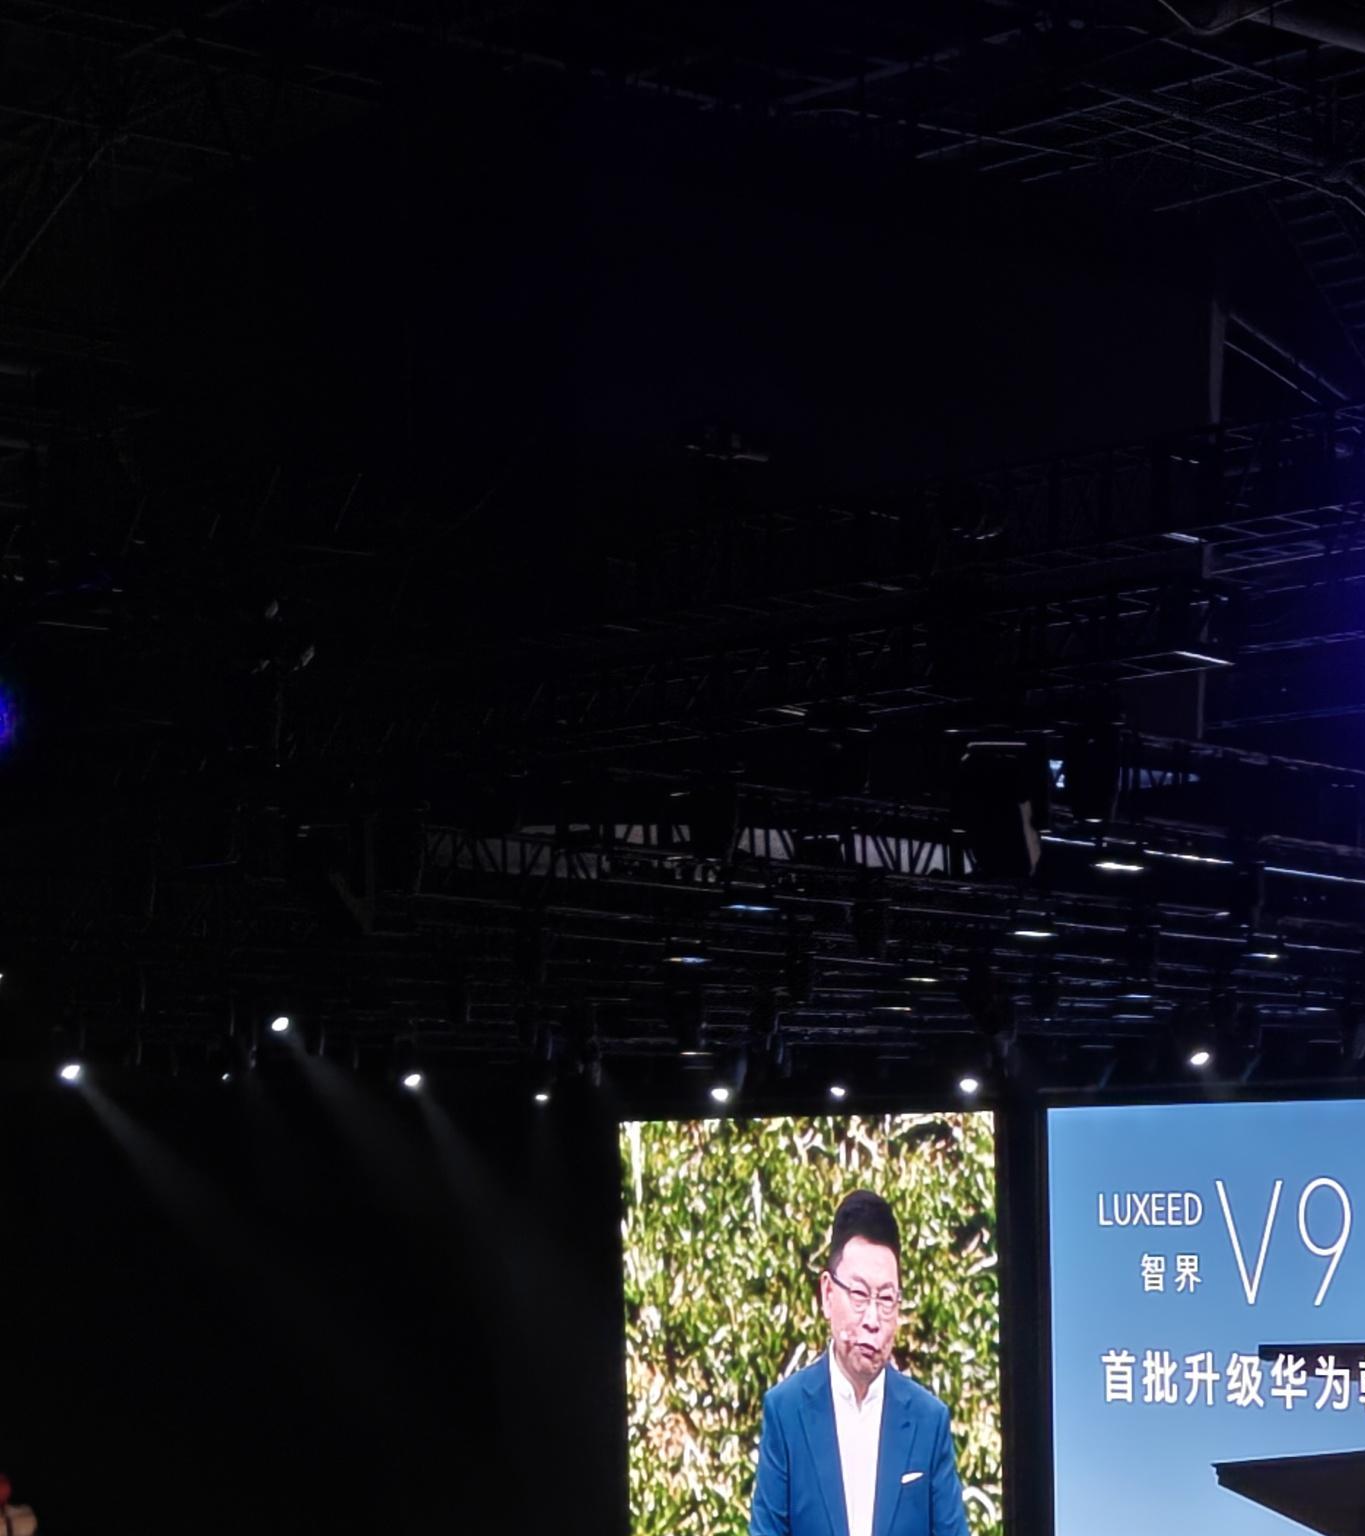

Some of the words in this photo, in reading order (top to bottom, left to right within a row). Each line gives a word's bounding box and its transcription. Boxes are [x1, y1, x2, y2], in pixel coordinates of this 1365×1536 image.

[1098, 1192, 1203, 1226] LUXEED
[1215, 1176, 1352, 1306] V9
[1140, 1252, 1202, 1293] 智界
